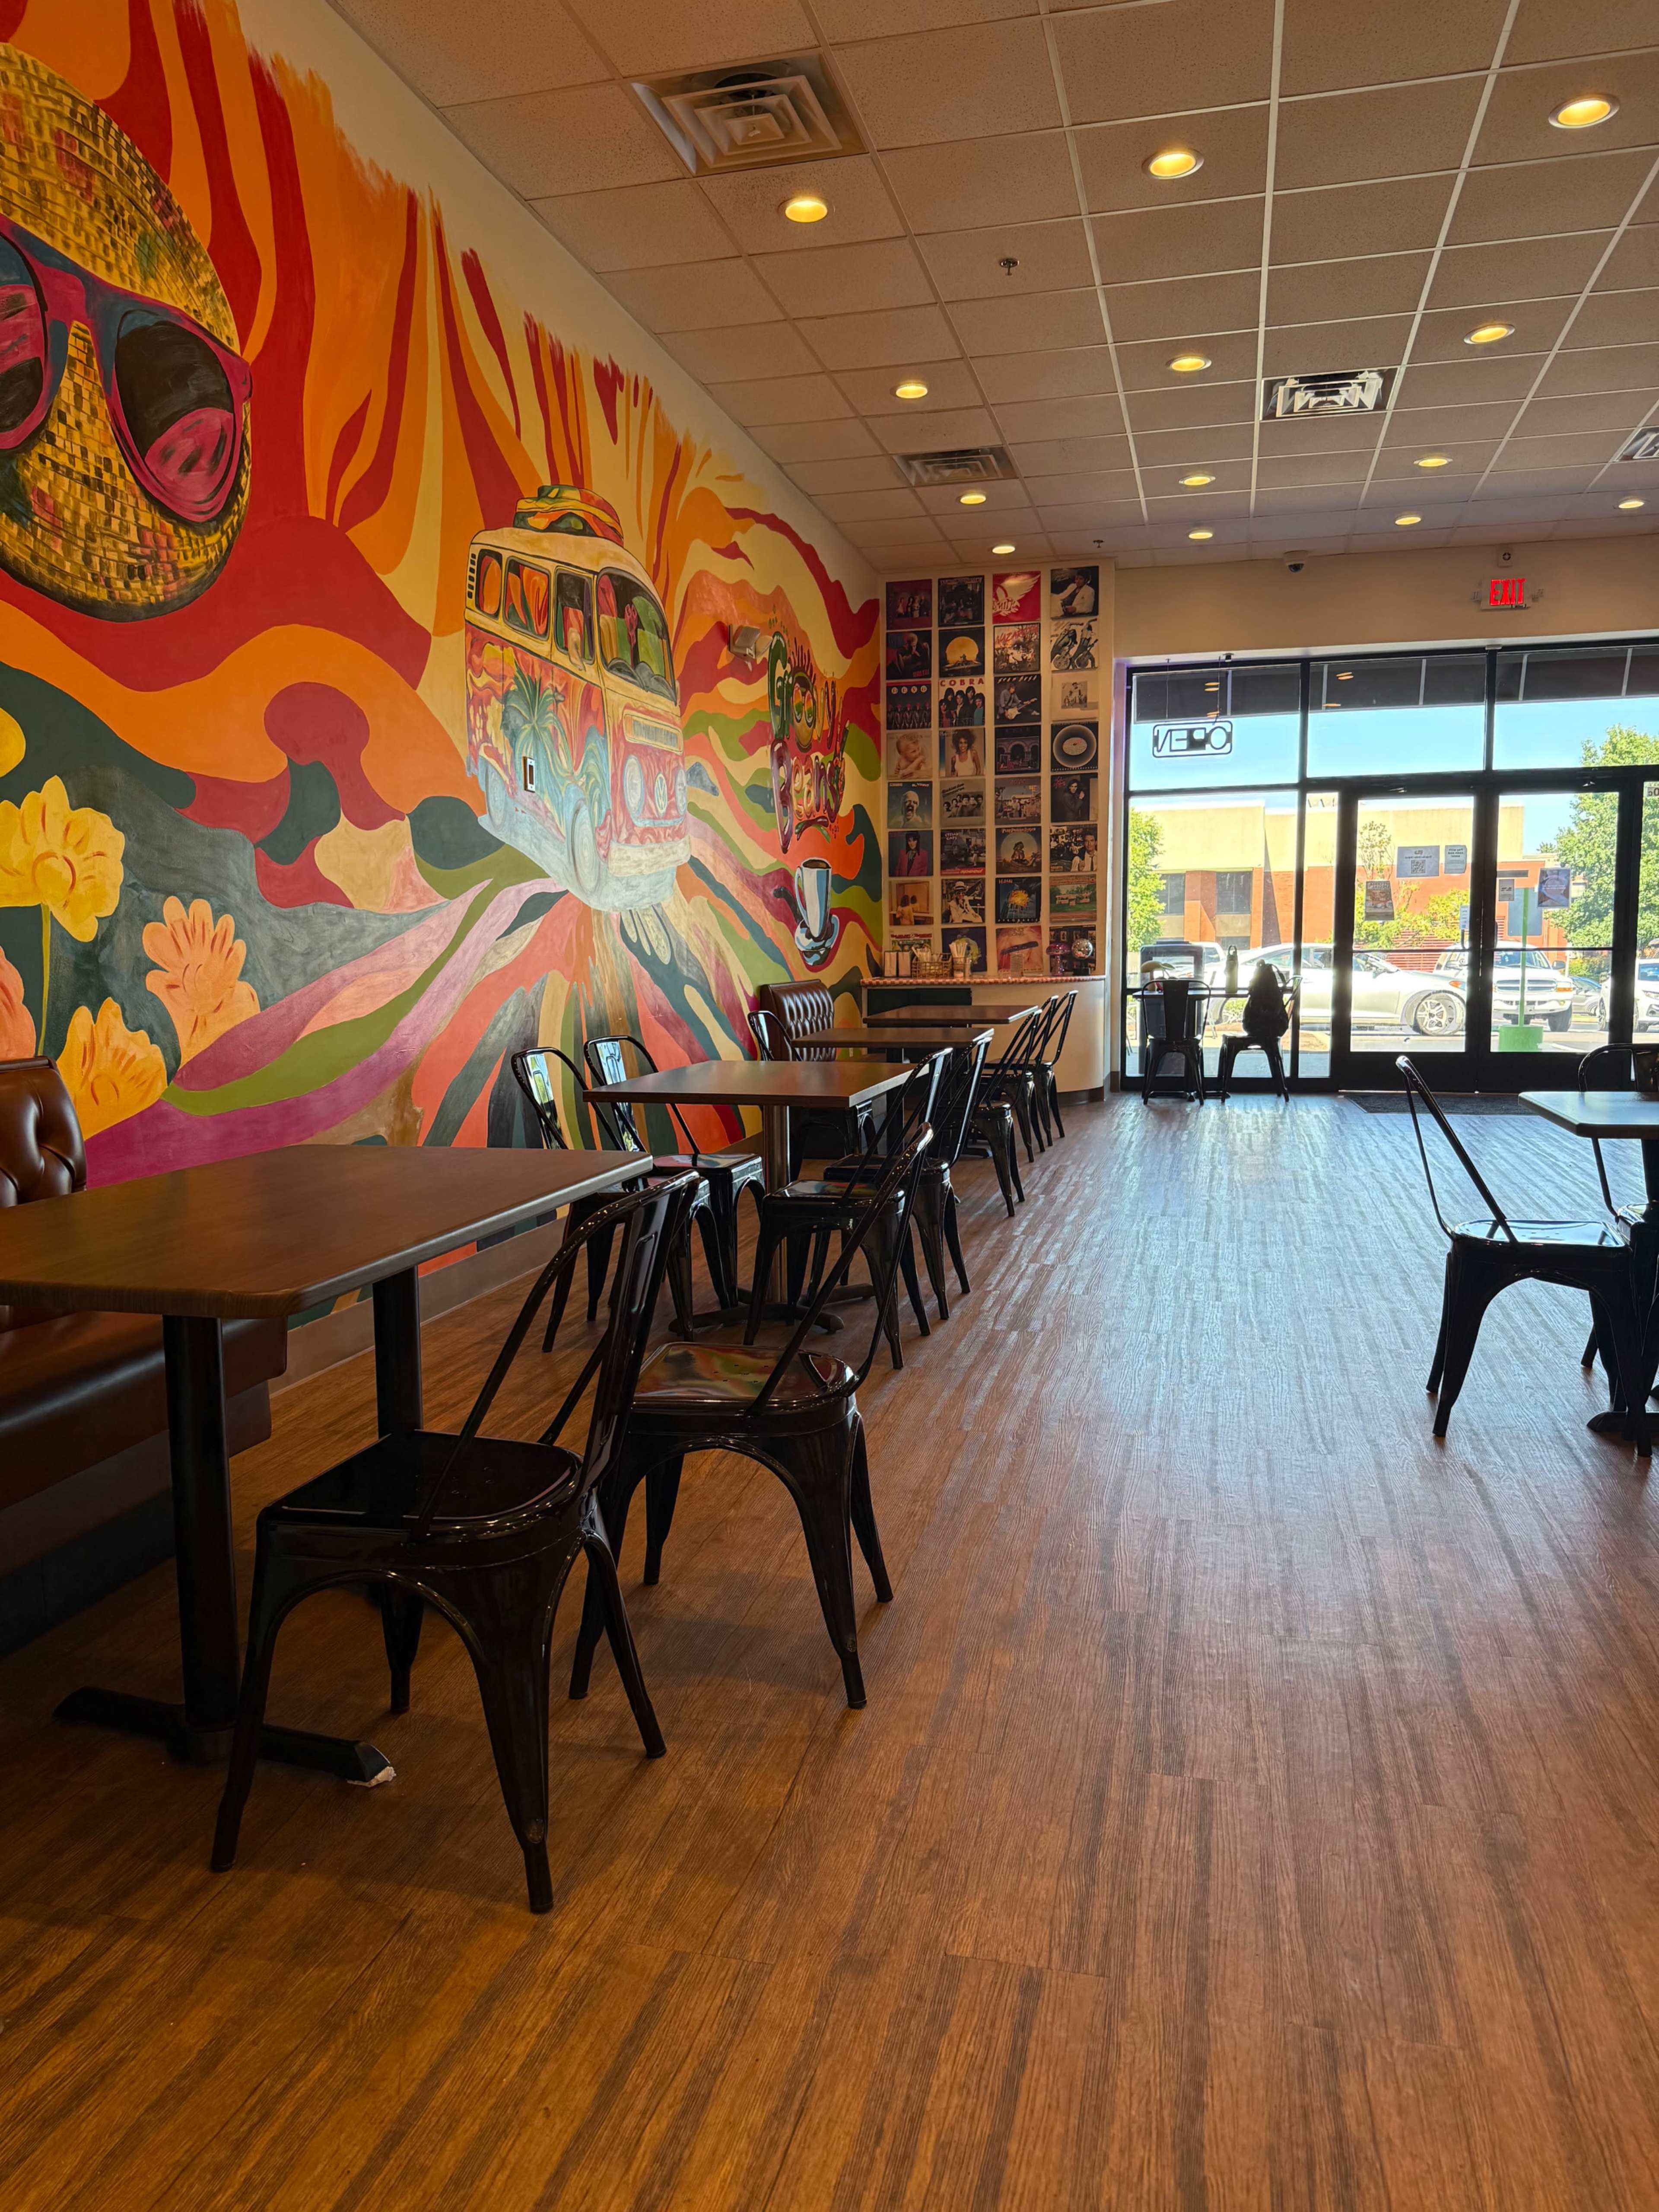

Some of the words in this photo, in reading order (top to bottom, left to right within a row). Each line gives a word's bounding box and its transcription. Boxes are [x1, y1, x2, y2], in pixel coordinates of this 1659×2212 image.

[1490, 578, 1526, 606] EXIT
[768, 631, 836, 751] Groovy
[940, 678, 984, 687] COBRA
[770, 739, 840, 854] Beans
